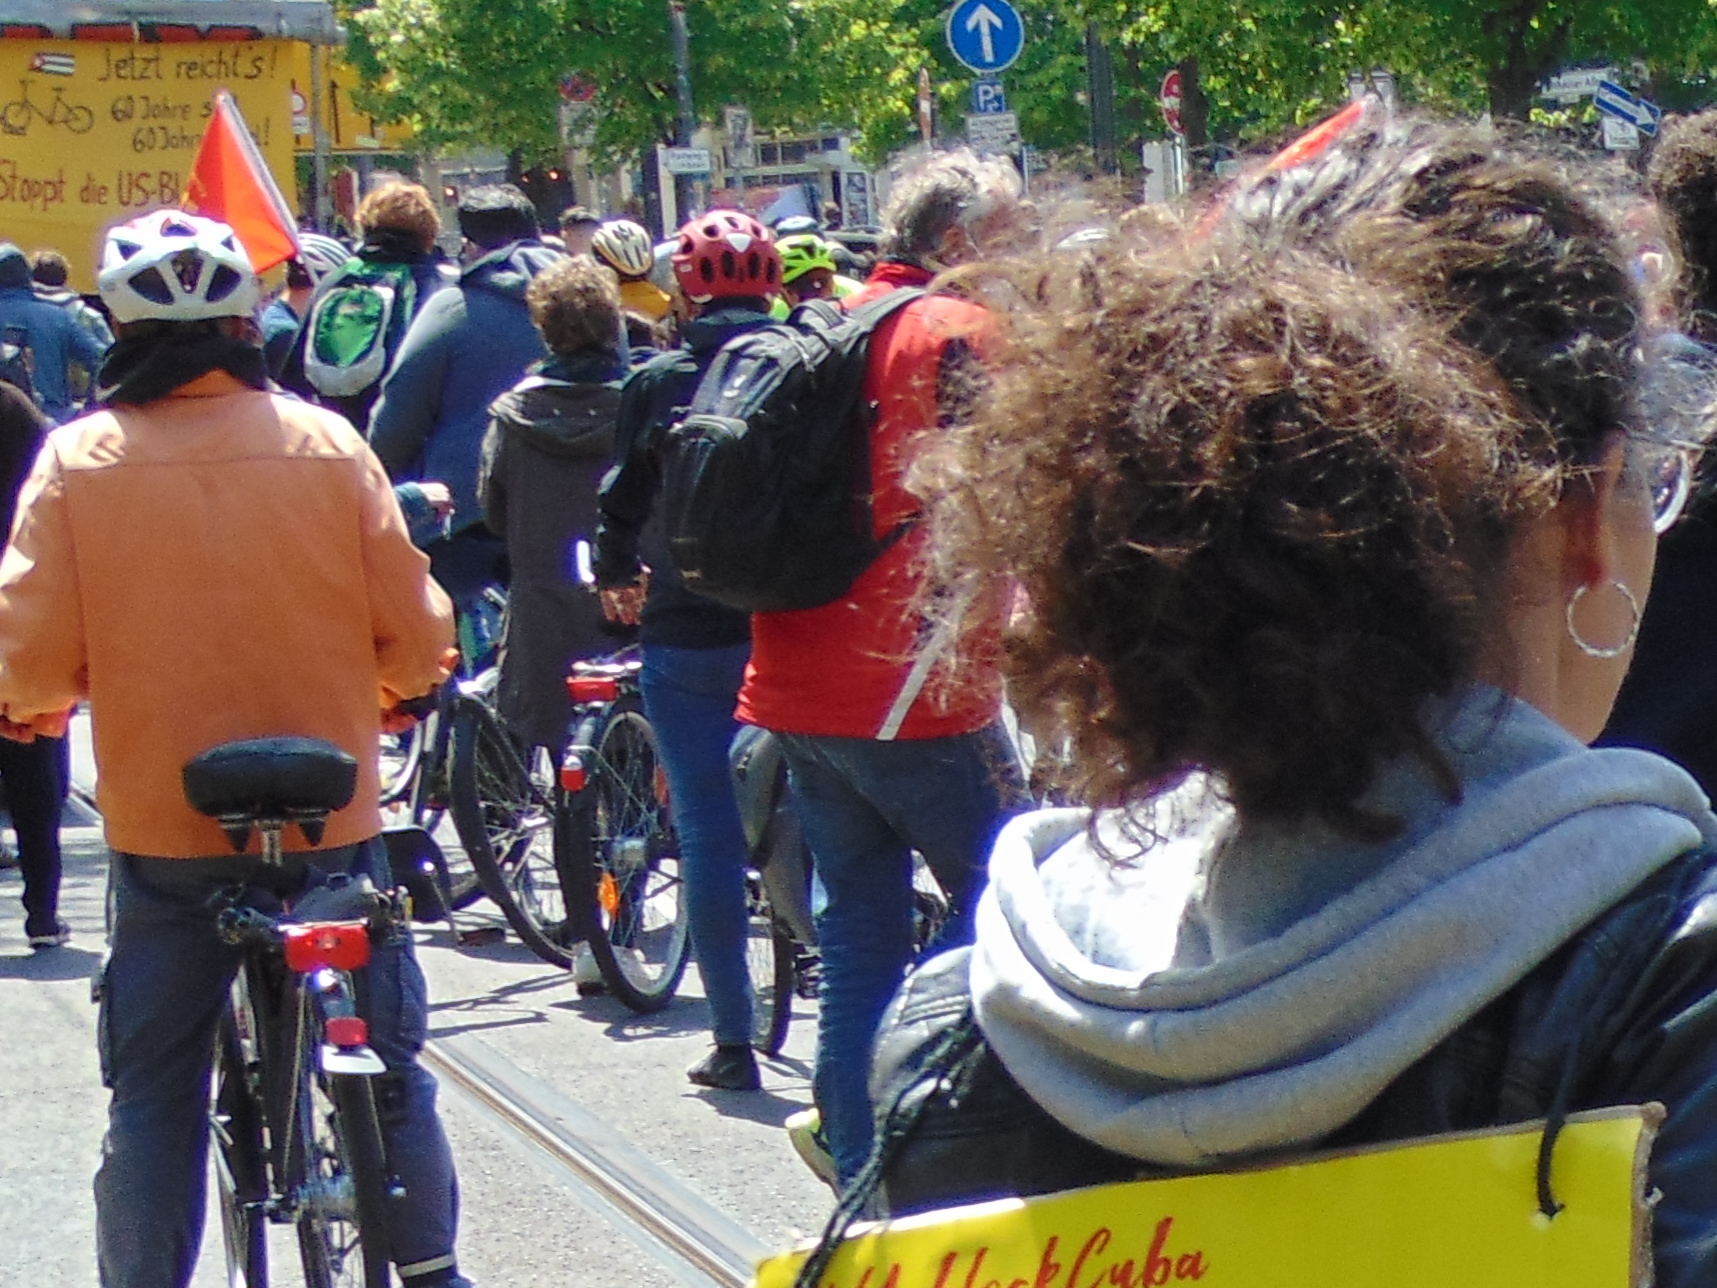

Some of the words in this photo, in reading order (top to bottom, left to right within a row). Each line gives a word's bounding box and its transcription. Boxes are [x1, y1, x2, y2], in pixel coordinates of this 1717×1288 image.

[97, 47, 163, 82] Jetzt
[110, 96, 134, 122] 60
[141, 96, 191, 121] Jahre
[132, 126, 156, 152] 60
[160, 126, 200, 149] Jahr
[0, 160, 65, 211] Stoppt
[80, 172, 108, 205] die
[117, 171, 180, 206] US-Bl
